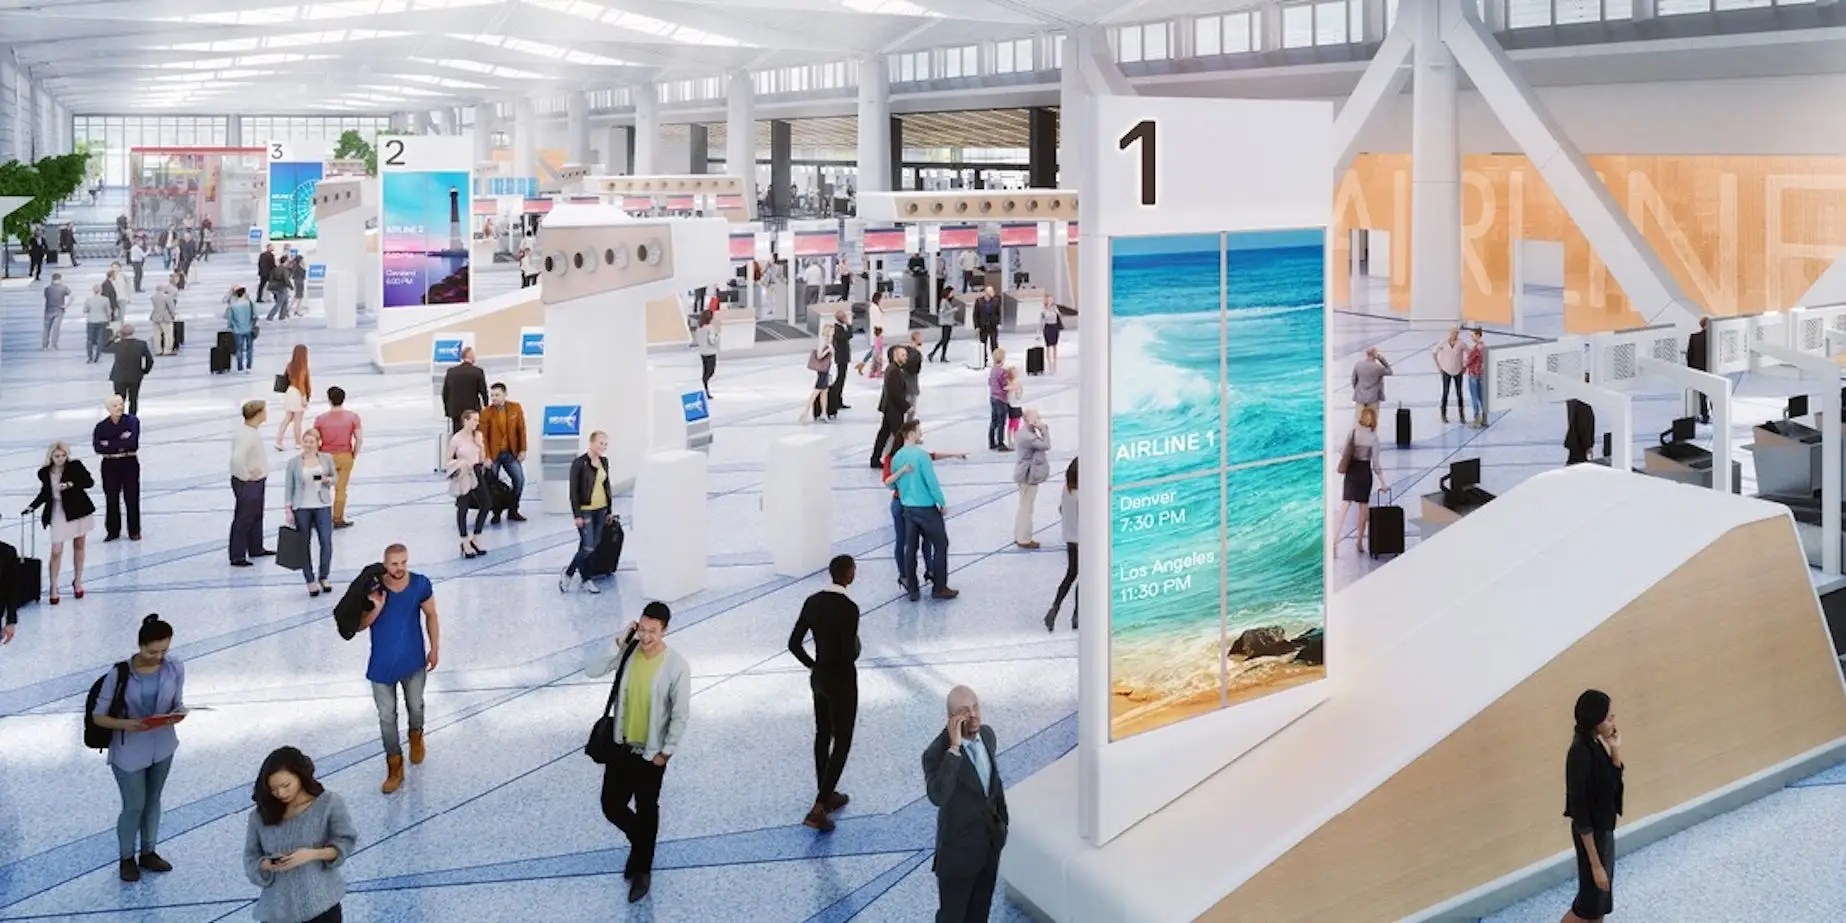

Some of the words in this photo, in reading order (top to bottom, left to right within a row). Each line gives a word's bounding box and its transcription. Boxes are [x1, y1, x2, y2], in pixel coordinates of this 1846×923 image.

[271, 143, 284, 160] 3
[385, 139, 405, 166] 2
[1118, 120, 1155, 205] 1
[1115, 432, 1201, 462] AIRLINE
[1206, 429, 1215, 448] 1
[1120, 490, 1177, 512] Denver
[1120, 513, 1154, 533] 7:30
[1158, 508, 1187, 527] PM
[1119, 564, 1148, 582] Los
[1151, 550, 1215, 574] Angeles
[1120, 582, 1159, 602] 11:30
[1163, 575, 1192, 595] PM
